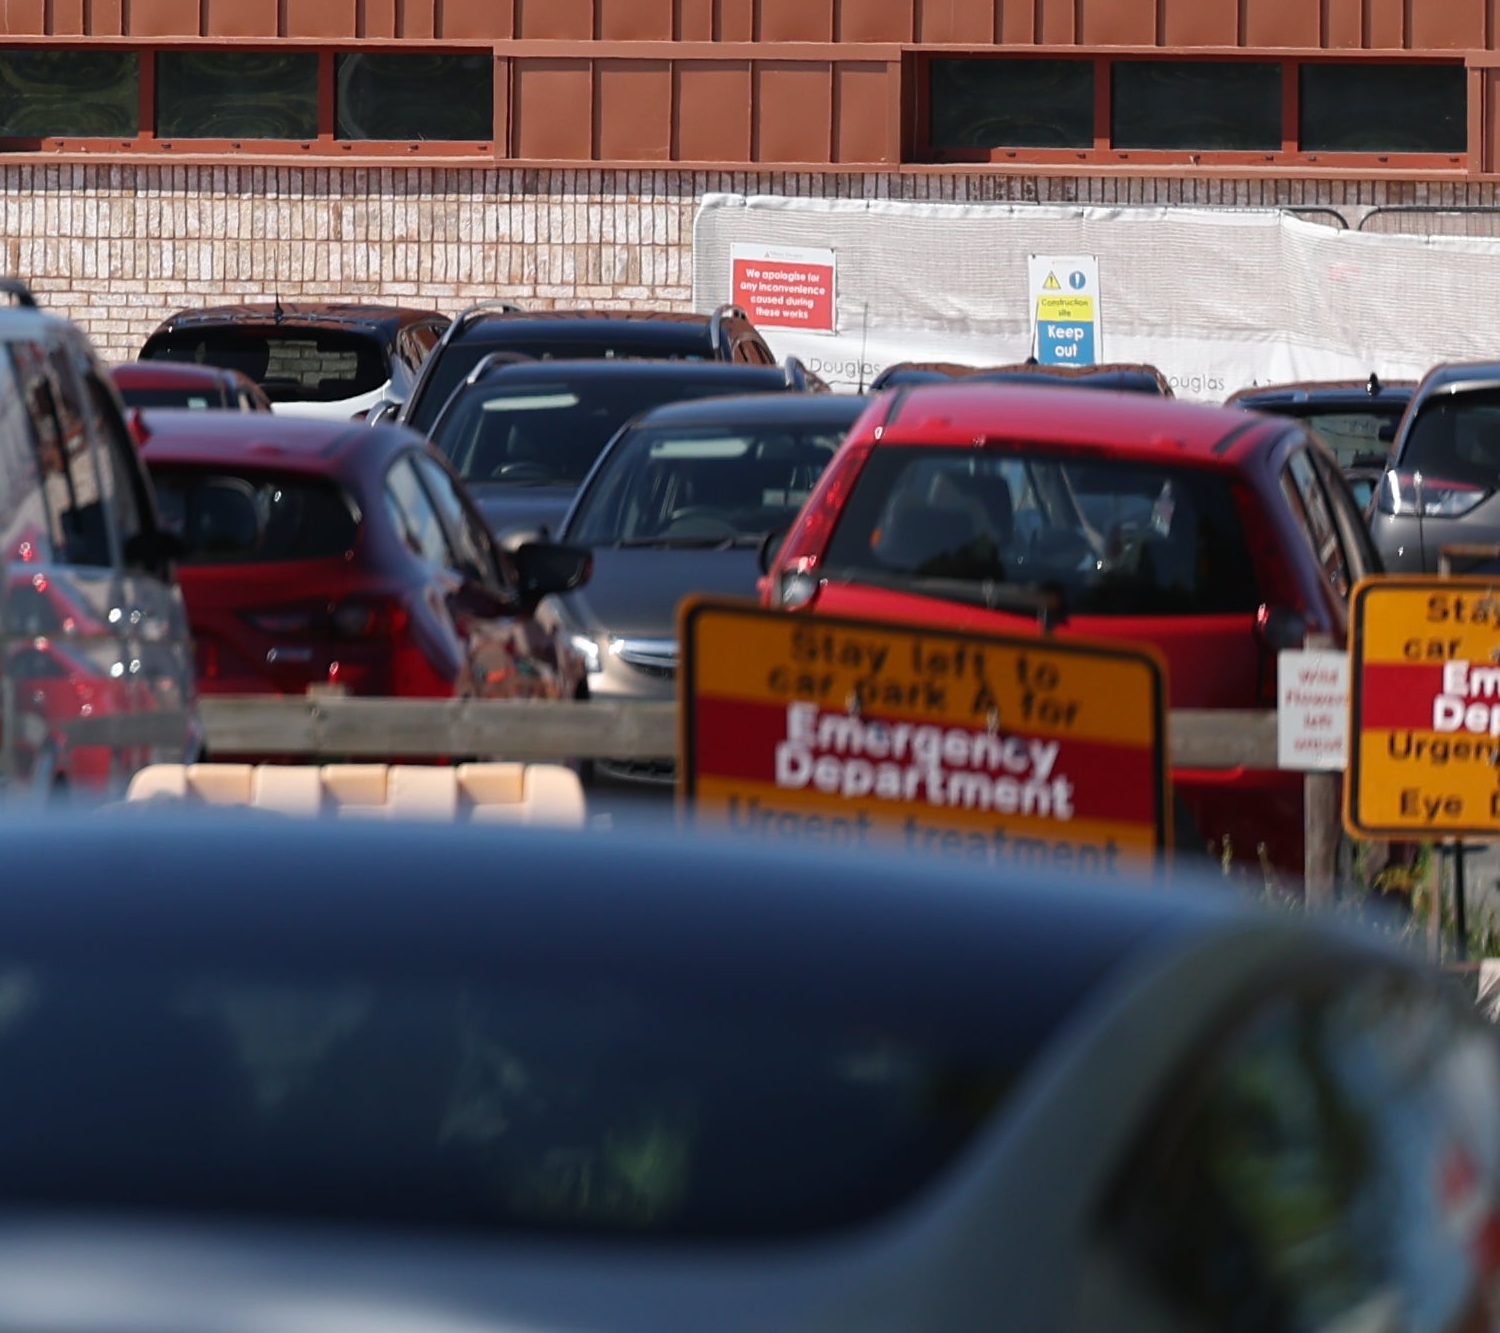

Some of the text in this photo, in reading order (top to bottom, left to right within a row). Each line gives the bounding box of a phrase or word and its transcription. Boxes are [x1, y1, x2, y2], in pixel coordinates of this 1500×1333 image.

[746, 268, 820, 282] We apologise for
[740, 281, 825, 295] any inconvenience
[750, 295, 814, 309] caused during
[1041, 298, 1088, 307] Construction
[755, 307, 808, 320] these works
[1047, 324, 1084, 342] Keep
[1055, 343, 1078, 358] out
[810, 358, 881, 379] Douglas
[788, 626, 1061, 691] Stay left to
[1404, 637, 1462, 661] car
[766, 665, 835, 698] car
[854, 677, 948, 717] park
[1021, 693, 1080, 727] for
[786, 700, 1062, 781] Emergency
[774, 740, 1074, 821] Department
[1400, 789, 1463, 821] Eye
